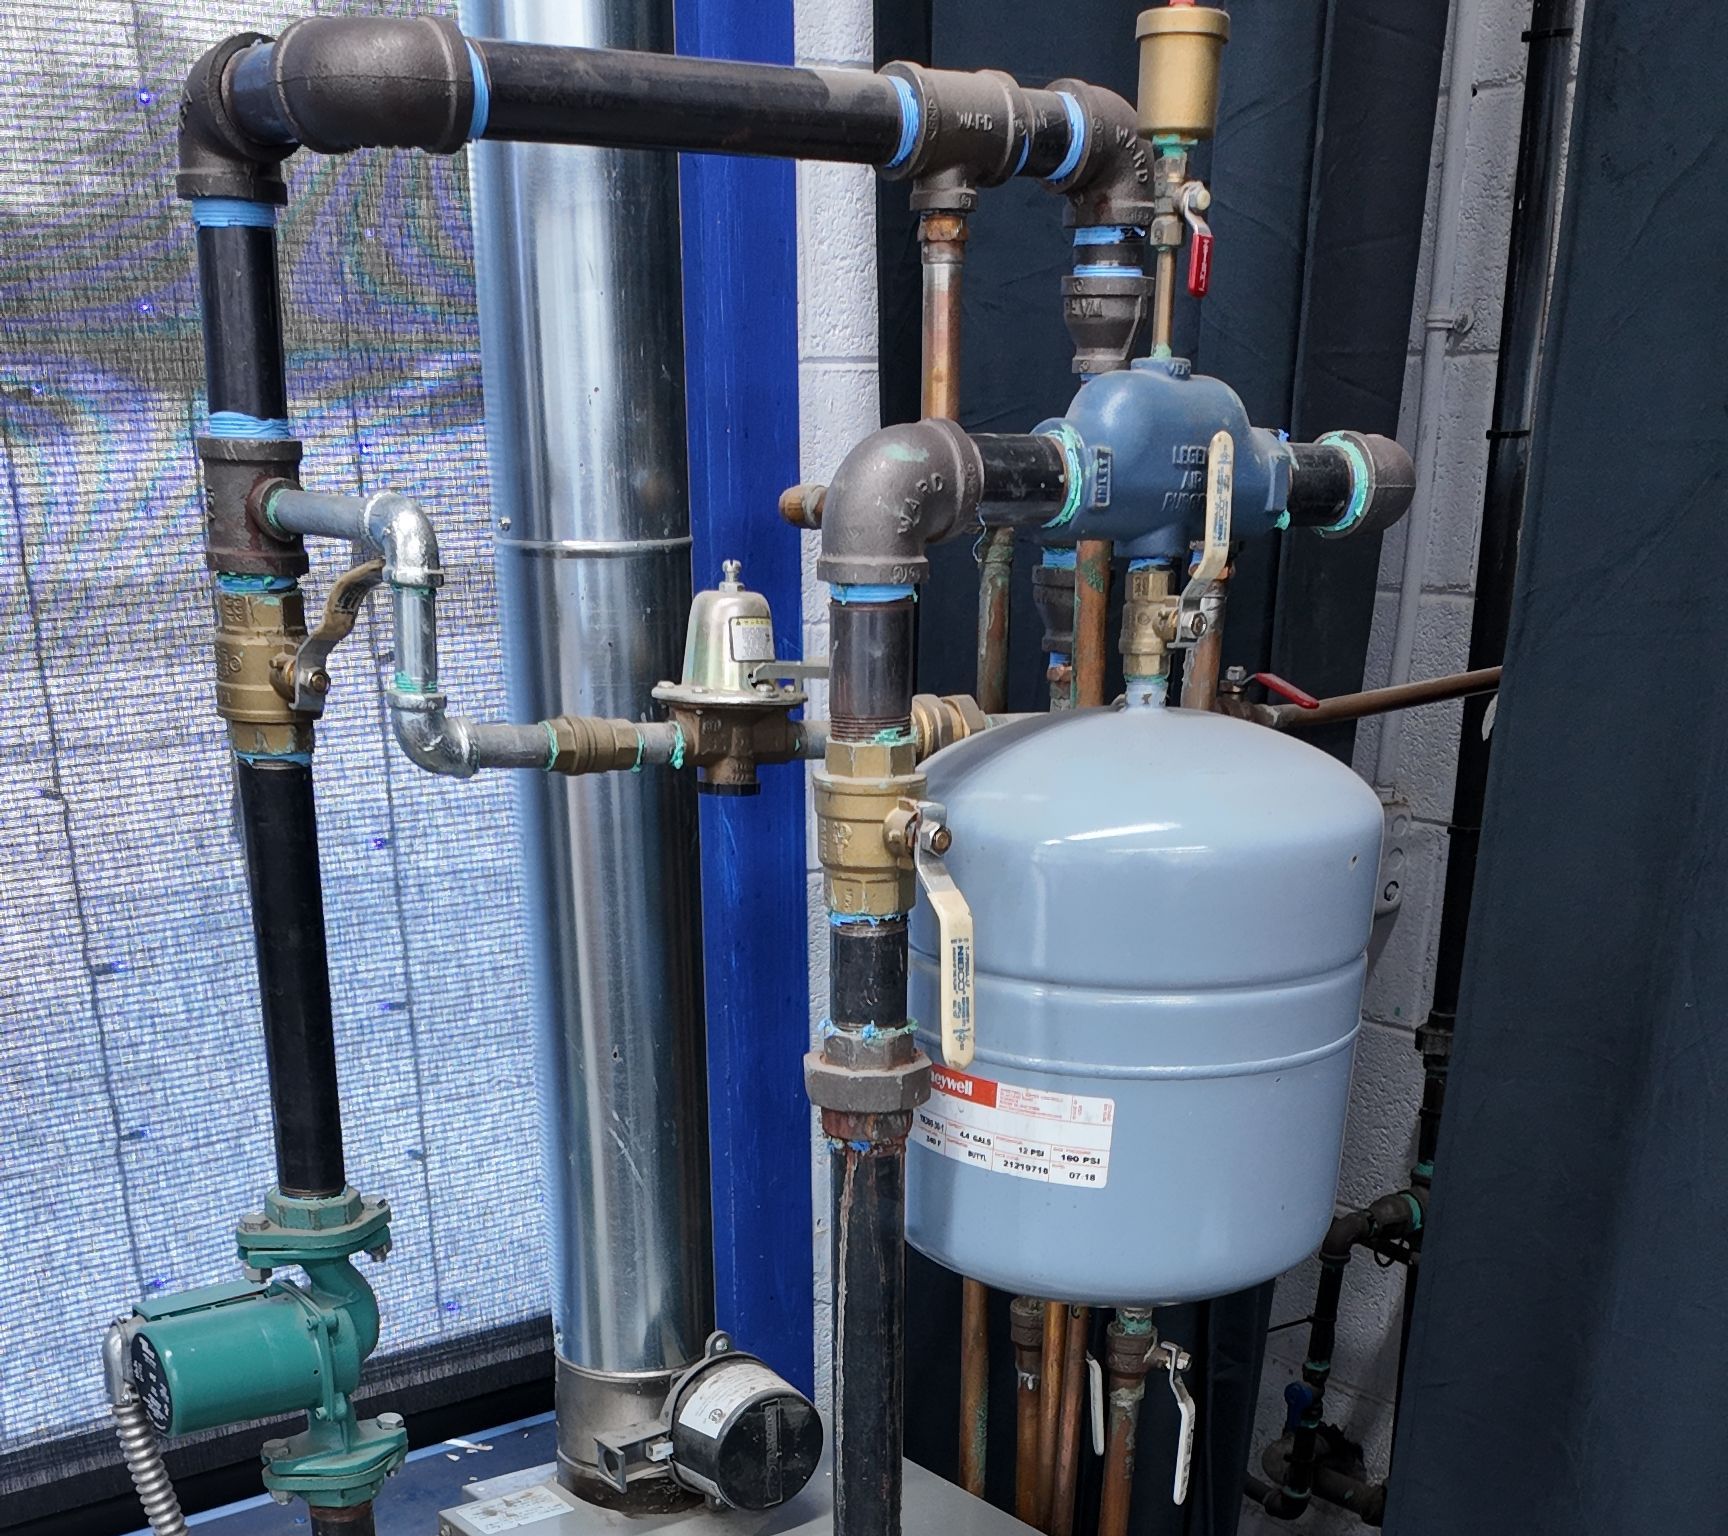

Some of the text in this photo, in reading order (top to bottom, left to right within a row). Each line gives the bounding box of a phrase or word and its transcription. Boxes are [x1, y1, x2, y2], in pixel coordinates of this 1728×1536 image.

[956, 112, 993, 131] WARD
[1115, 124, 1149, 184] WARD
[896, 472, 943, 534] WARD
[967, 1150, 987, 1162] BUTYL
[1030, 1148, 1045, 1158] PSI
[1082, 1157, 1101, 1165] PSI
